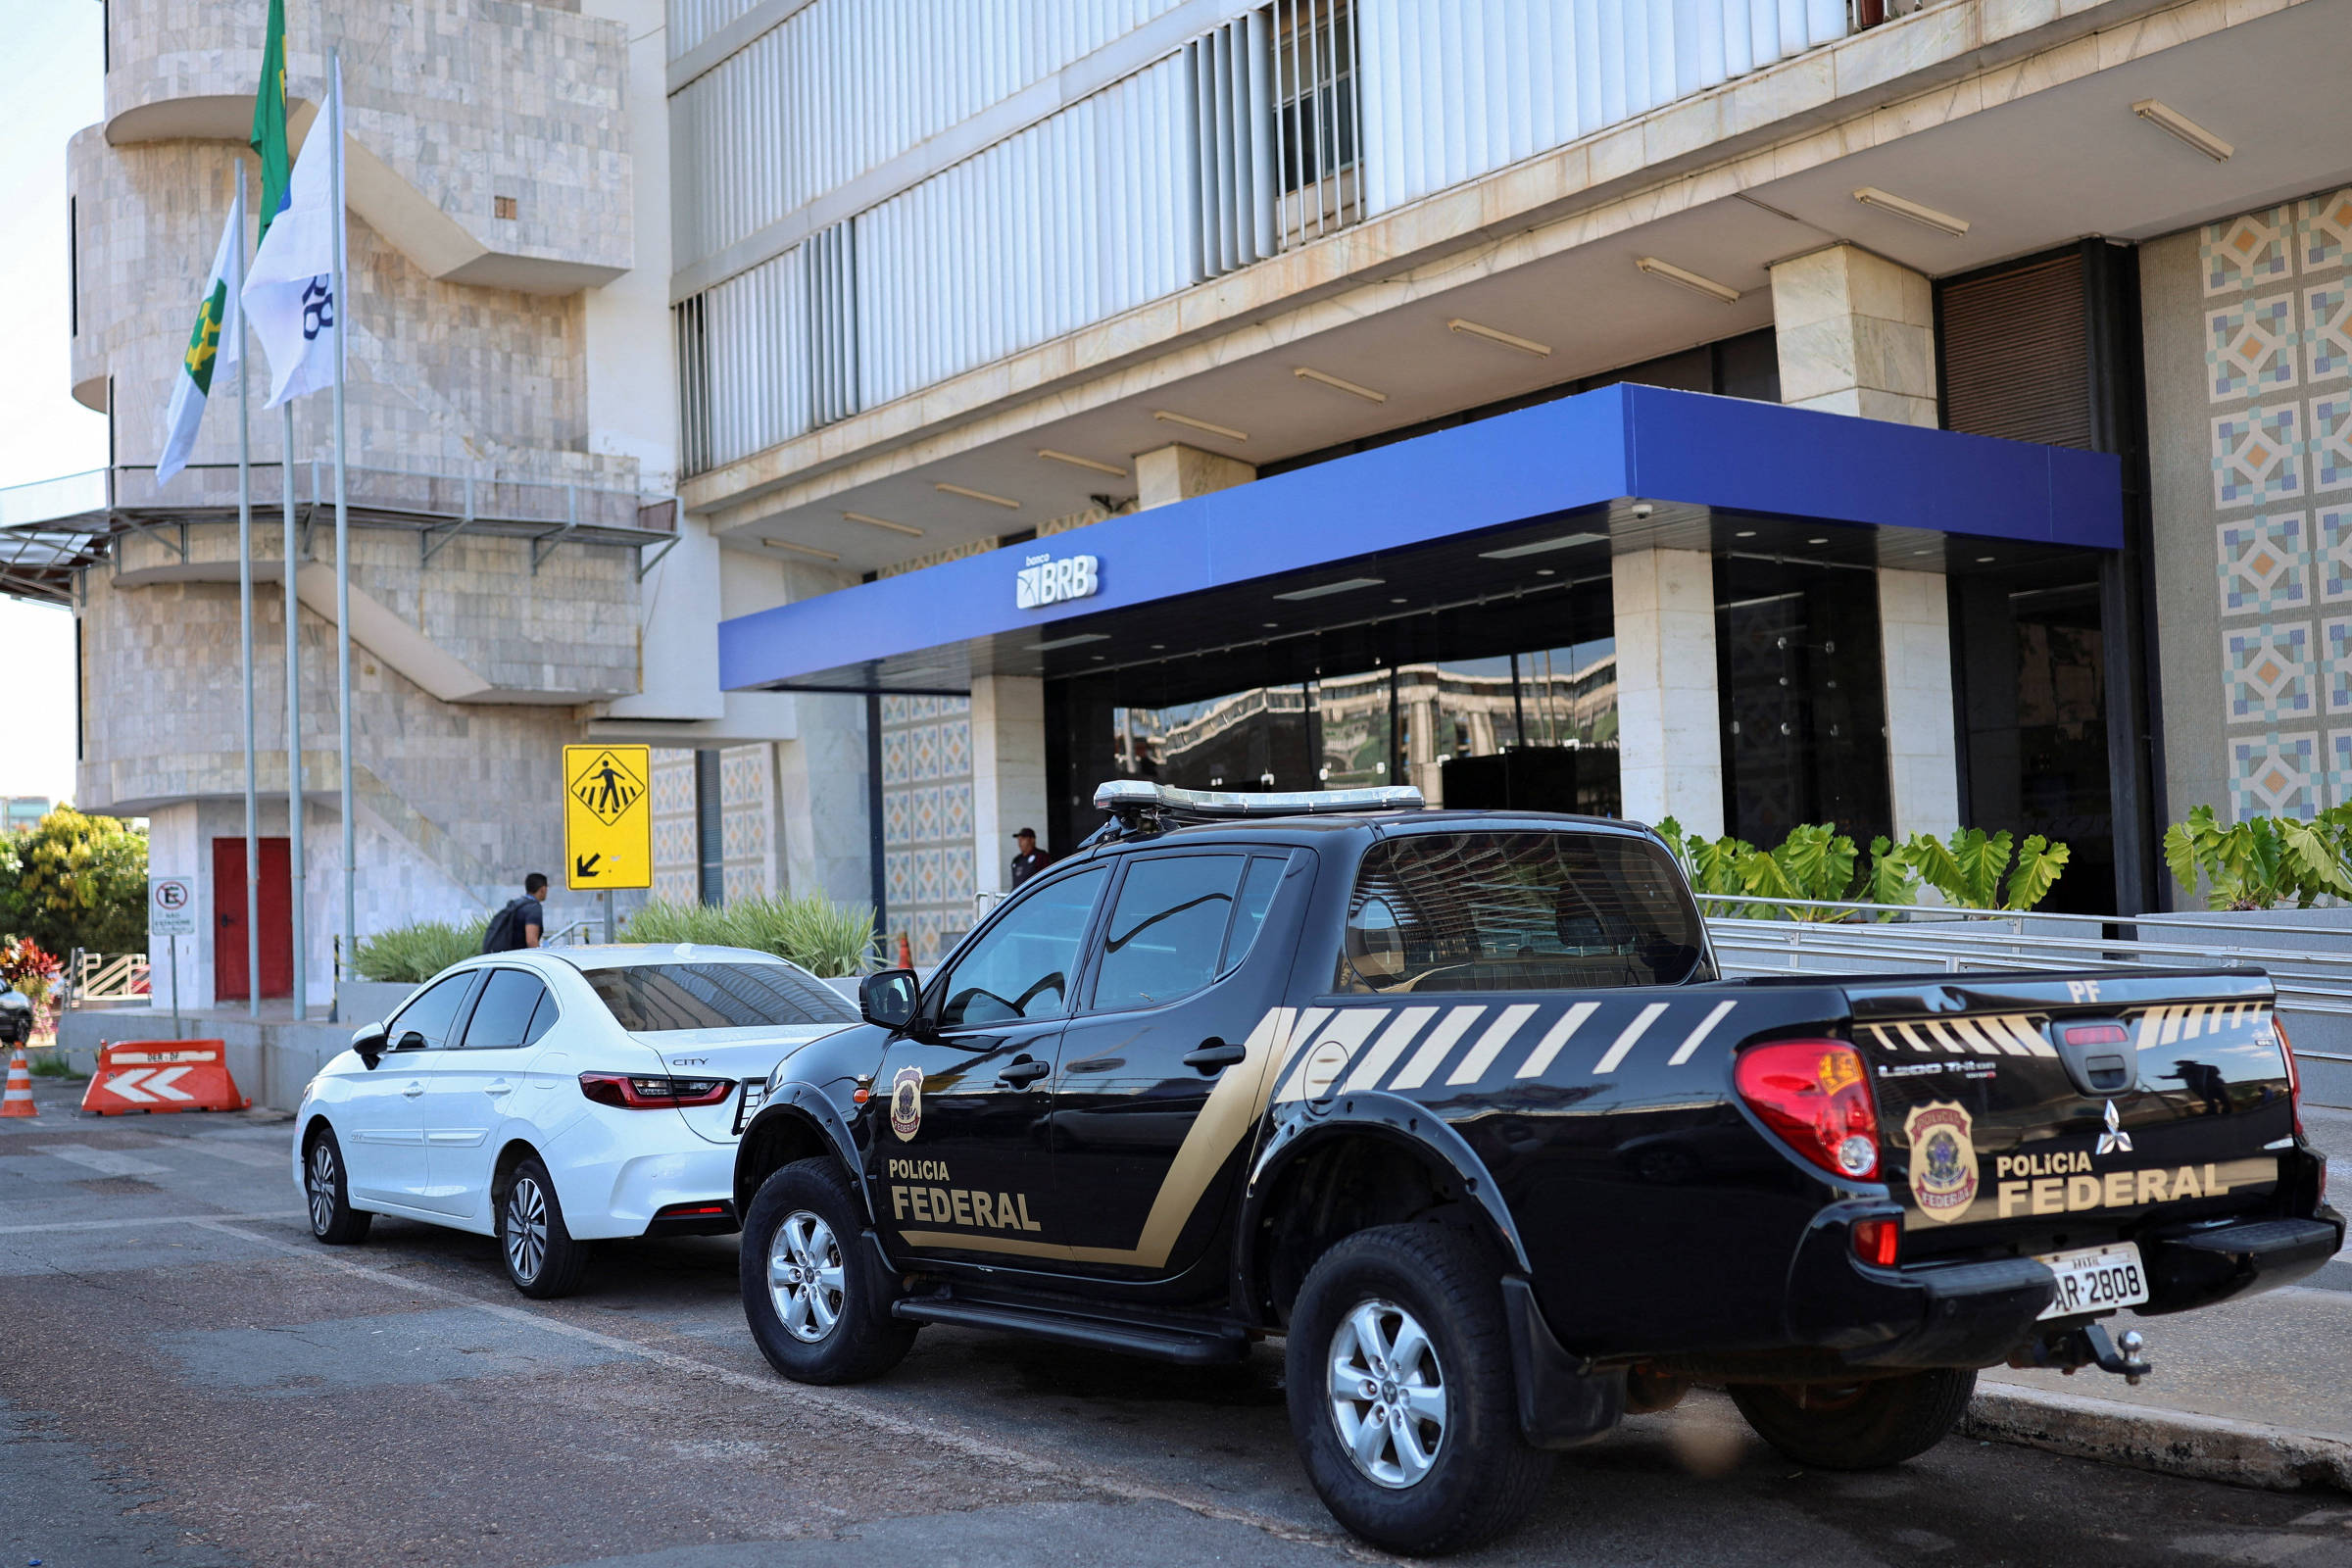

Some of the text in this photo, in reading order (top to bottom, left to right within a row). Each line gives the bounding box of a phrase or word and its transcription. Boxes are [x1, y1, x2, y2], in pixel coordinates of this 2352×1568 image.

[1040, 555, 1098, 605] BRB
[2067, 980, 2101, 1004] PF
[672, 1057, 710, 1066] CITY
[891, 1185, 1042, 1232] FEDERAL
[1922, 1188, 1970, 1207] FEDERAL
[1997, 1163, 2230, 1219] FEDERAL
[2055, 1265, 2141, 1312] AR-2808
